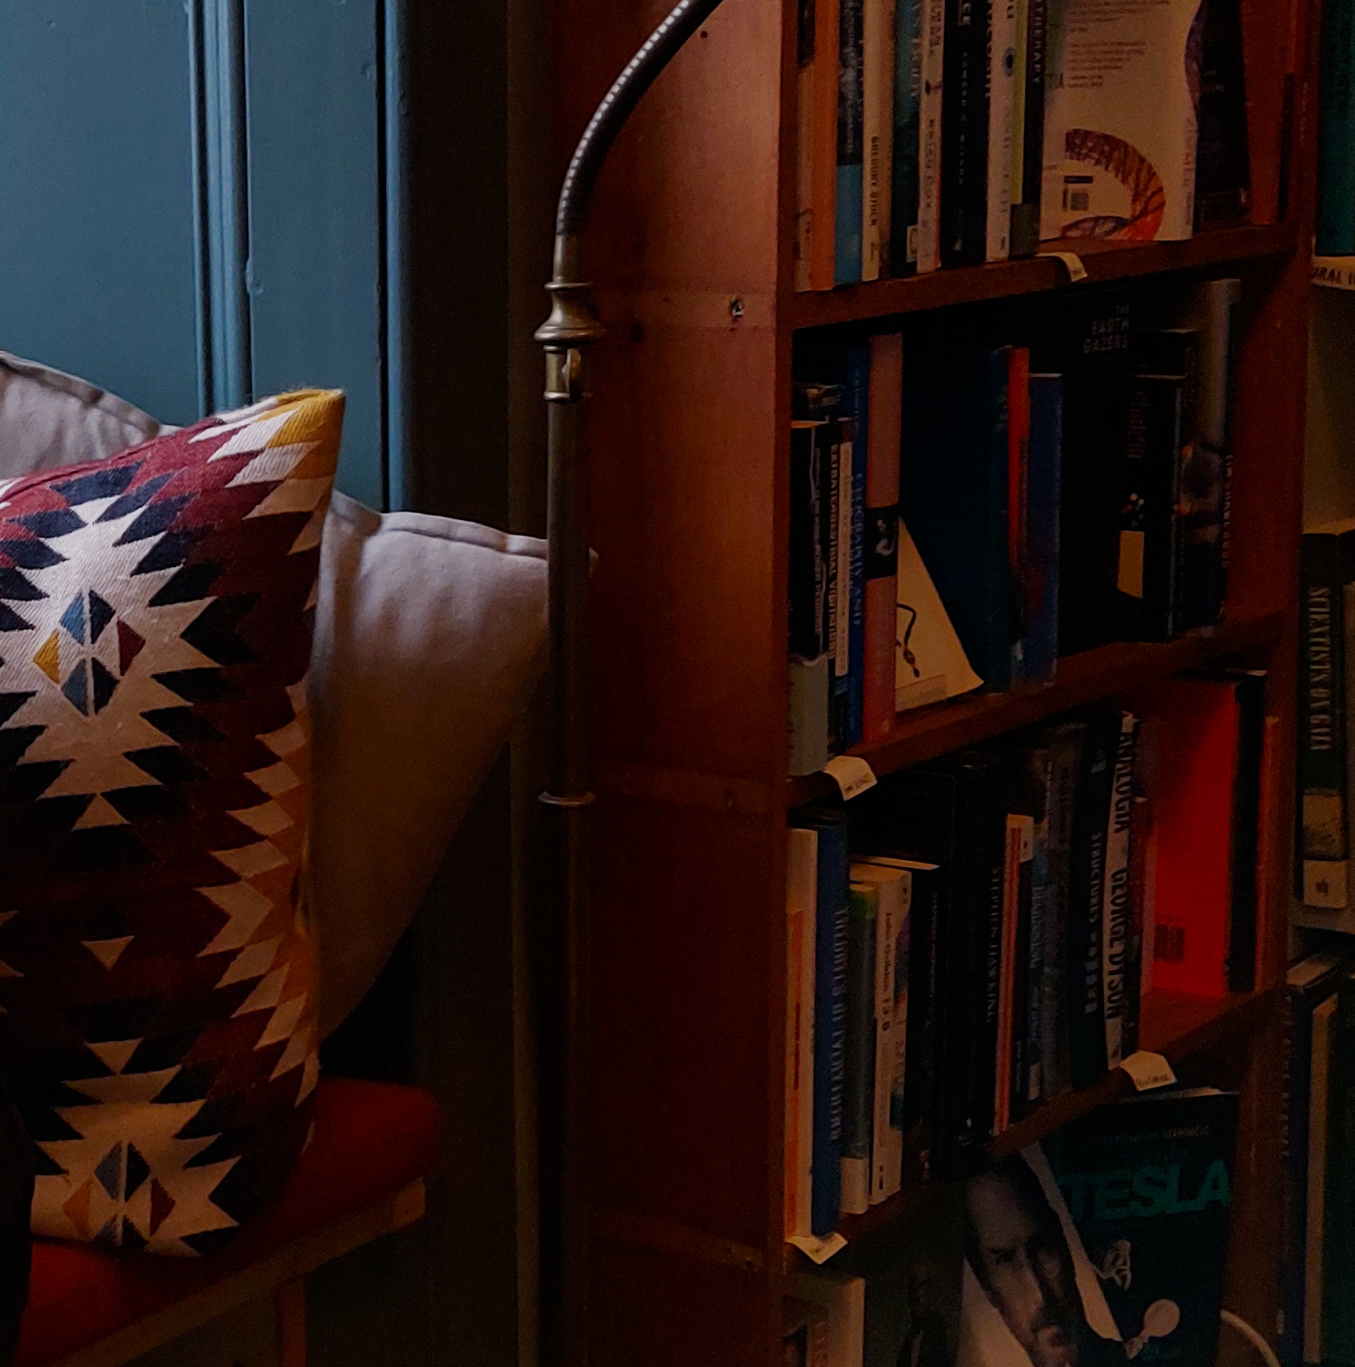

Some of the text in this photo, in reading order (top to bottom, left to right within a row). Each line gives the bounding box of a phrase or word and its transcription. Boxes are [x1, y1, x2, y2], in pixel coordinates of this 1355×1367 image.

[1109, 869, 1128, 944] GEORGE
[1105, 952, 1125, 1019] DYSON
[1058, 1159, 1230, 1222] TESLA
